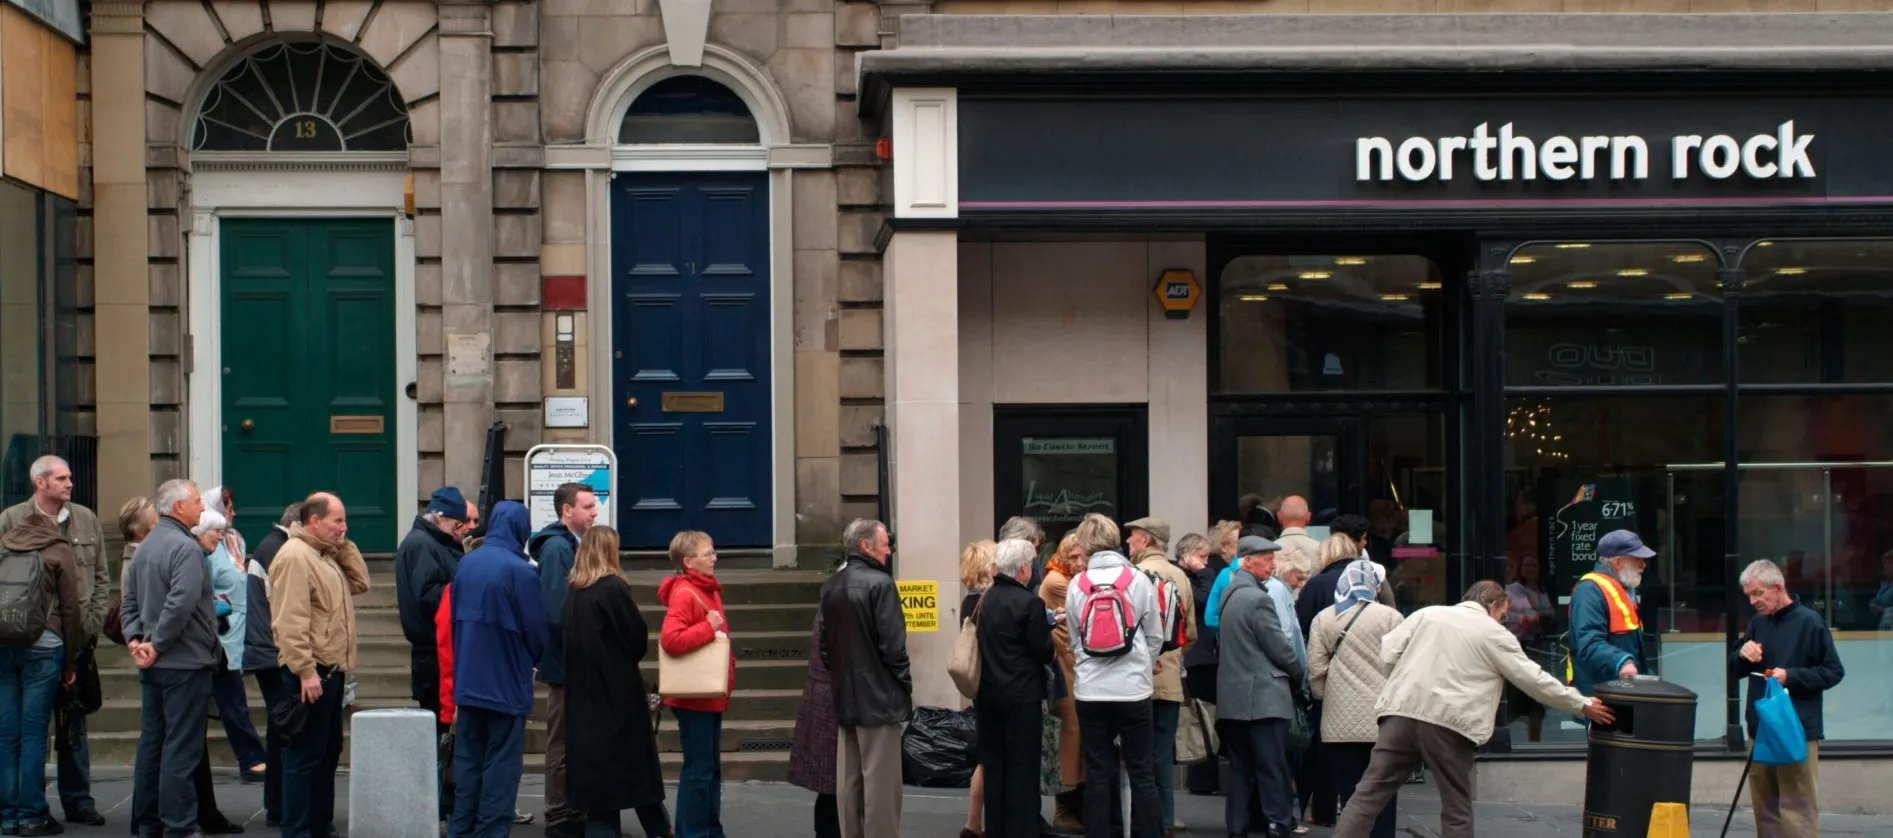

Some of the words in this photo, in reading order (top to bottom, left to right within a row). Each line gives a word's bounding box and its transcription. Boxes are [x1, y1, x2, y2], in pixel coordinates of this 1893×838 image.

[294, 120, 317, 138] 13
[1356, 121, 1648, 181] northern
[1672, 119, 1816, 179] rock
[1167, 285, 1189, 296] ADT
[1043, 442, 1076, 451] Castle
[1077, 442, 1110, 451] Street
[1571, 520, 1576, 530] 1
[1577, 522, 1598, 533] year
[1571, 530, 1596, 541] fixed
[1571, 541, 1591, 551] rate
[1571, 549, 1597, 561] bond
